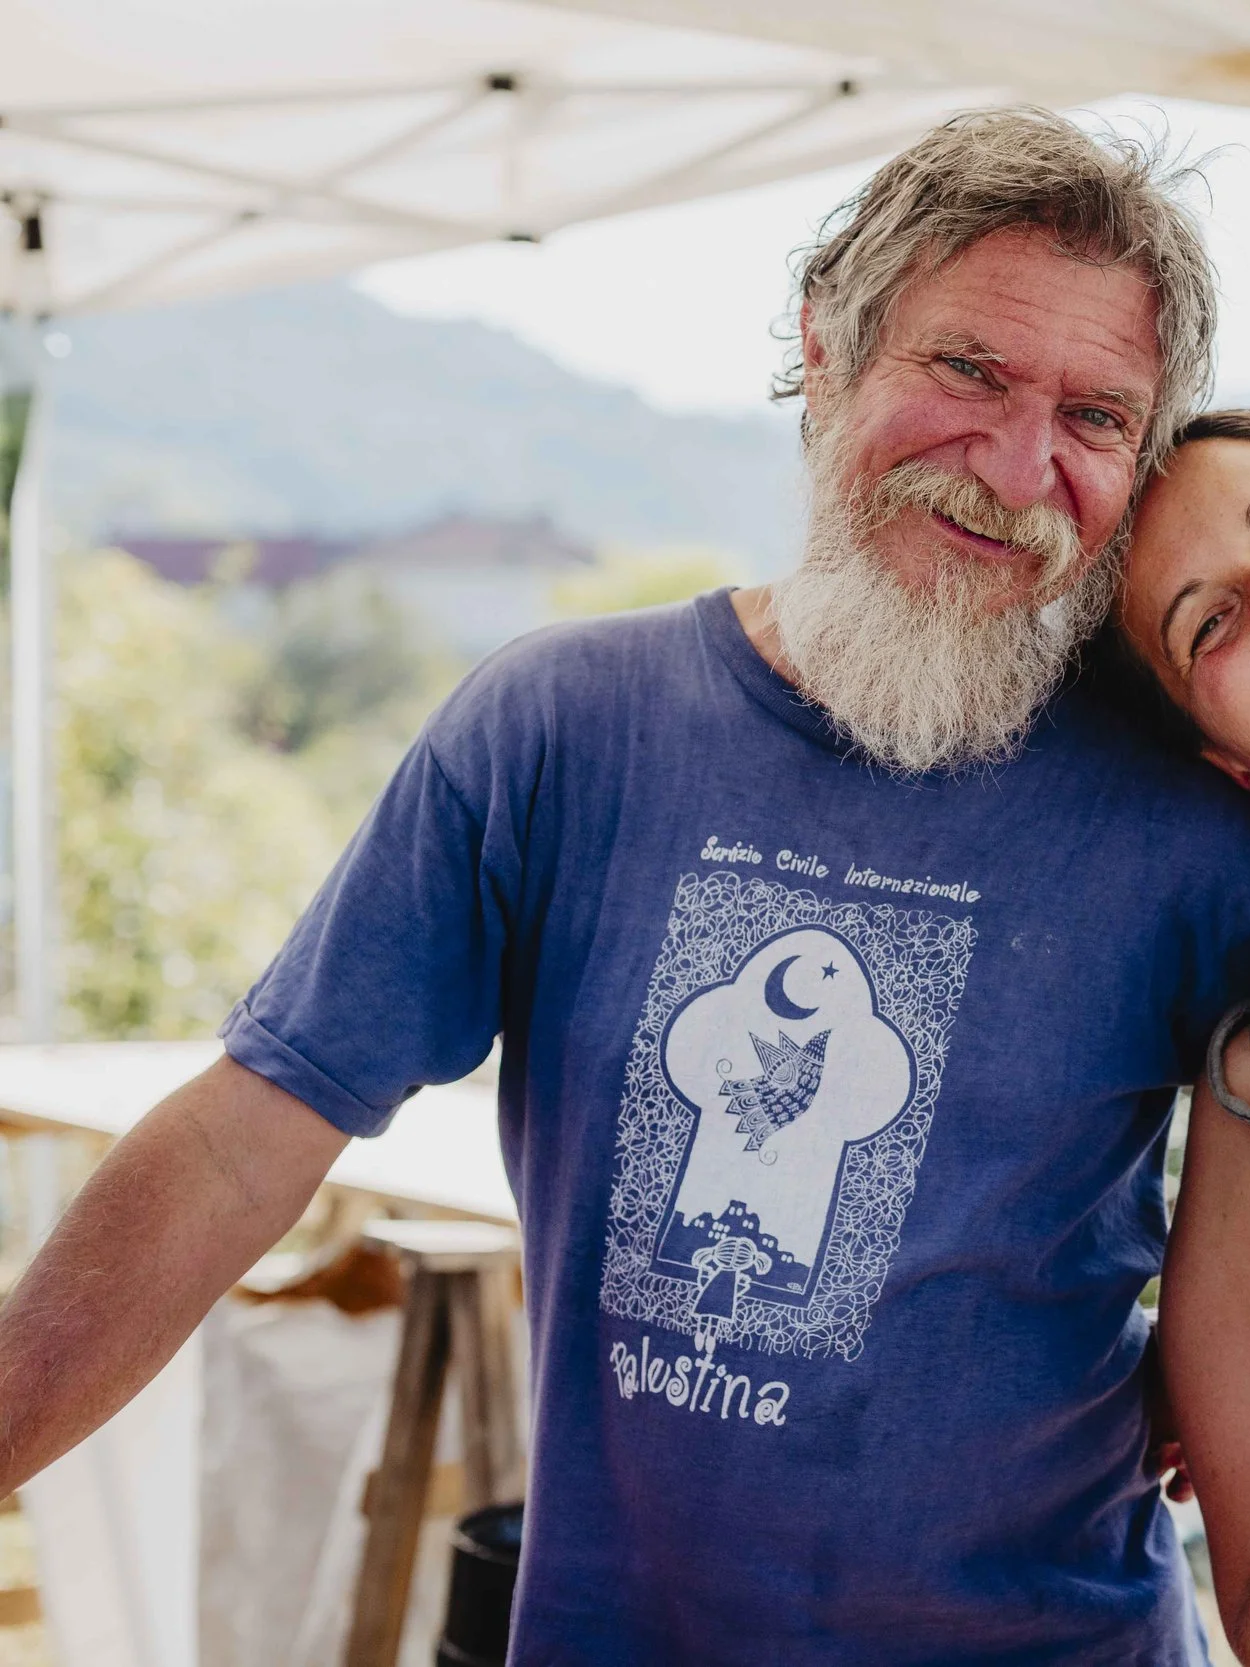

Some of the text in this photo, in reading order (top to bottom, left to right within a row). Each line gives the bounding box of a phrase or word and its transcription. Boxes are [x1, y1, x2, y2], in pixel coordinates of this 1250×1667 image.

[700, 835, 982, 904] Servizio Civile Internazionale
[609, 1335, 790, 1426] Palestina
